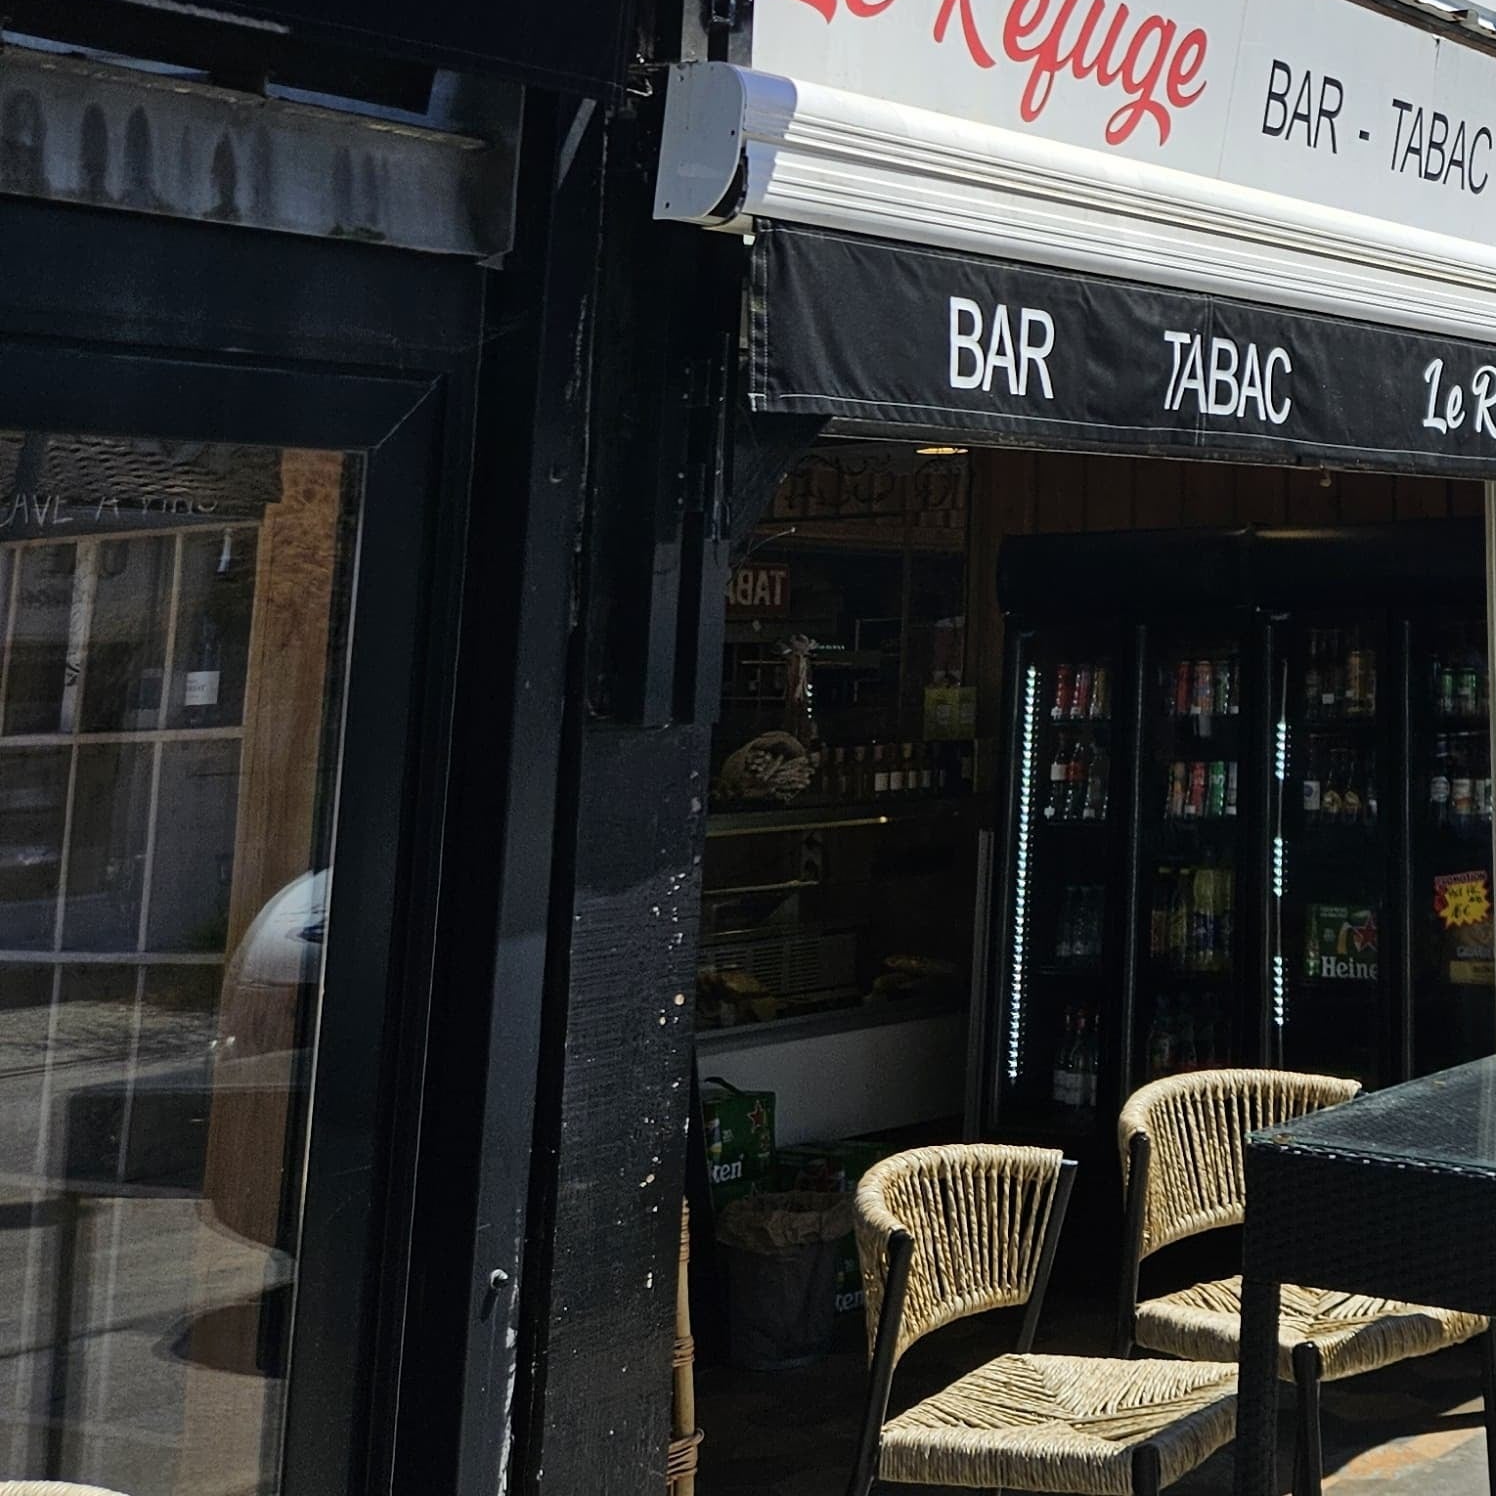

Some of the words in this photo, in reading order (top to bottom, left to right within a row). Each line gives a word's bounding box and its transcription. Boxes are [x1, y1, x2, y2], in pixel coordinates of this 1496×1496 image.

[1261, 59, 1345, 155] BAR
[1391, 99, 1493, 195] TABAC
[948, 295, 1056, 400] BAR
[1163, 330, 1292, 424] TABAC
[1422, 358, 1465, 435] Le
